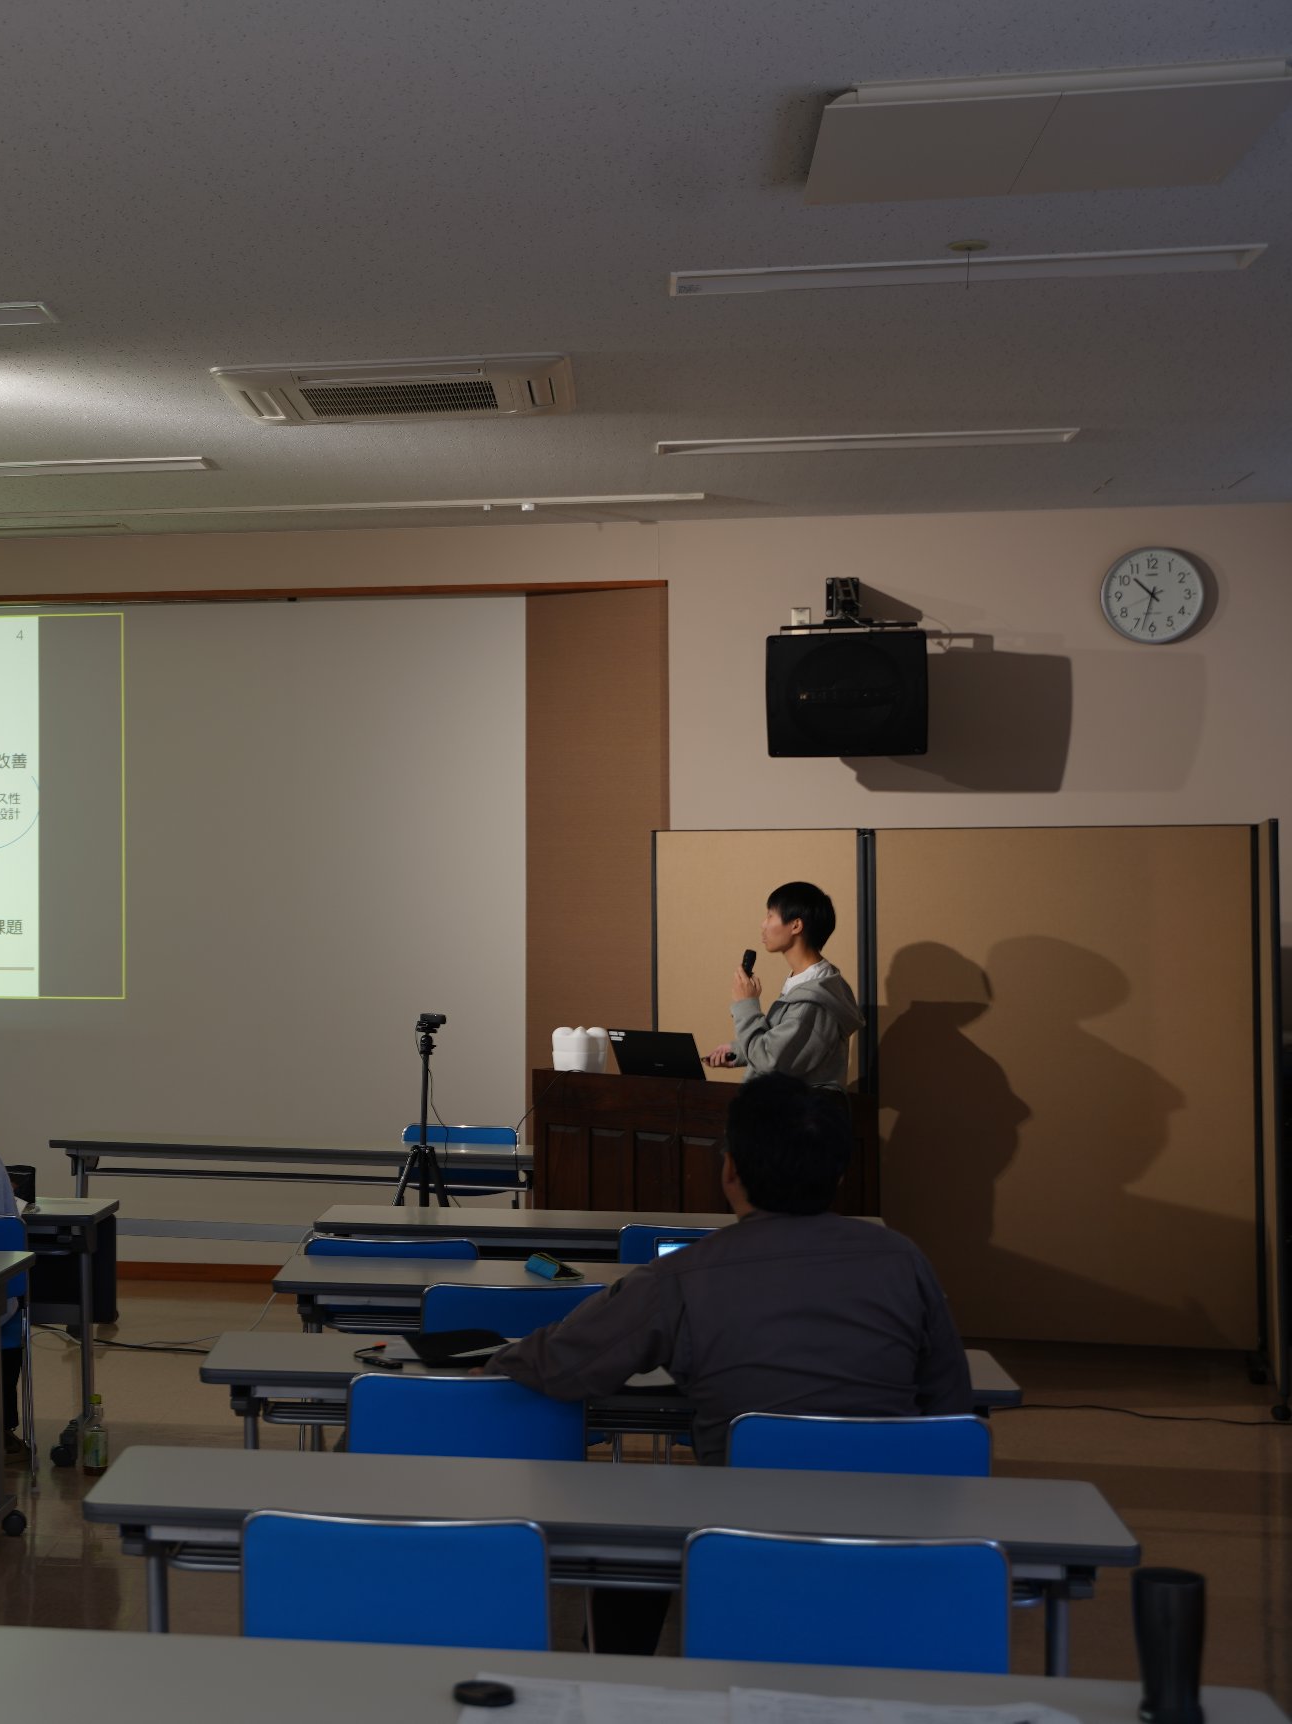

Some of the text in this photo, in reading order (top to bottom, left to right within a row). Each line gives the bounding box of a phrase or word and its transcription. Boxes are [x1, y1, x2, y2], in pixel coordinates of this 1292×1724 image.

[1130, 563, 1139, 575] 11
[1146, 558, 1158, 569] 12
[1119, 575, 1130, 586] 10
[16, 629, 24, 641] 4
